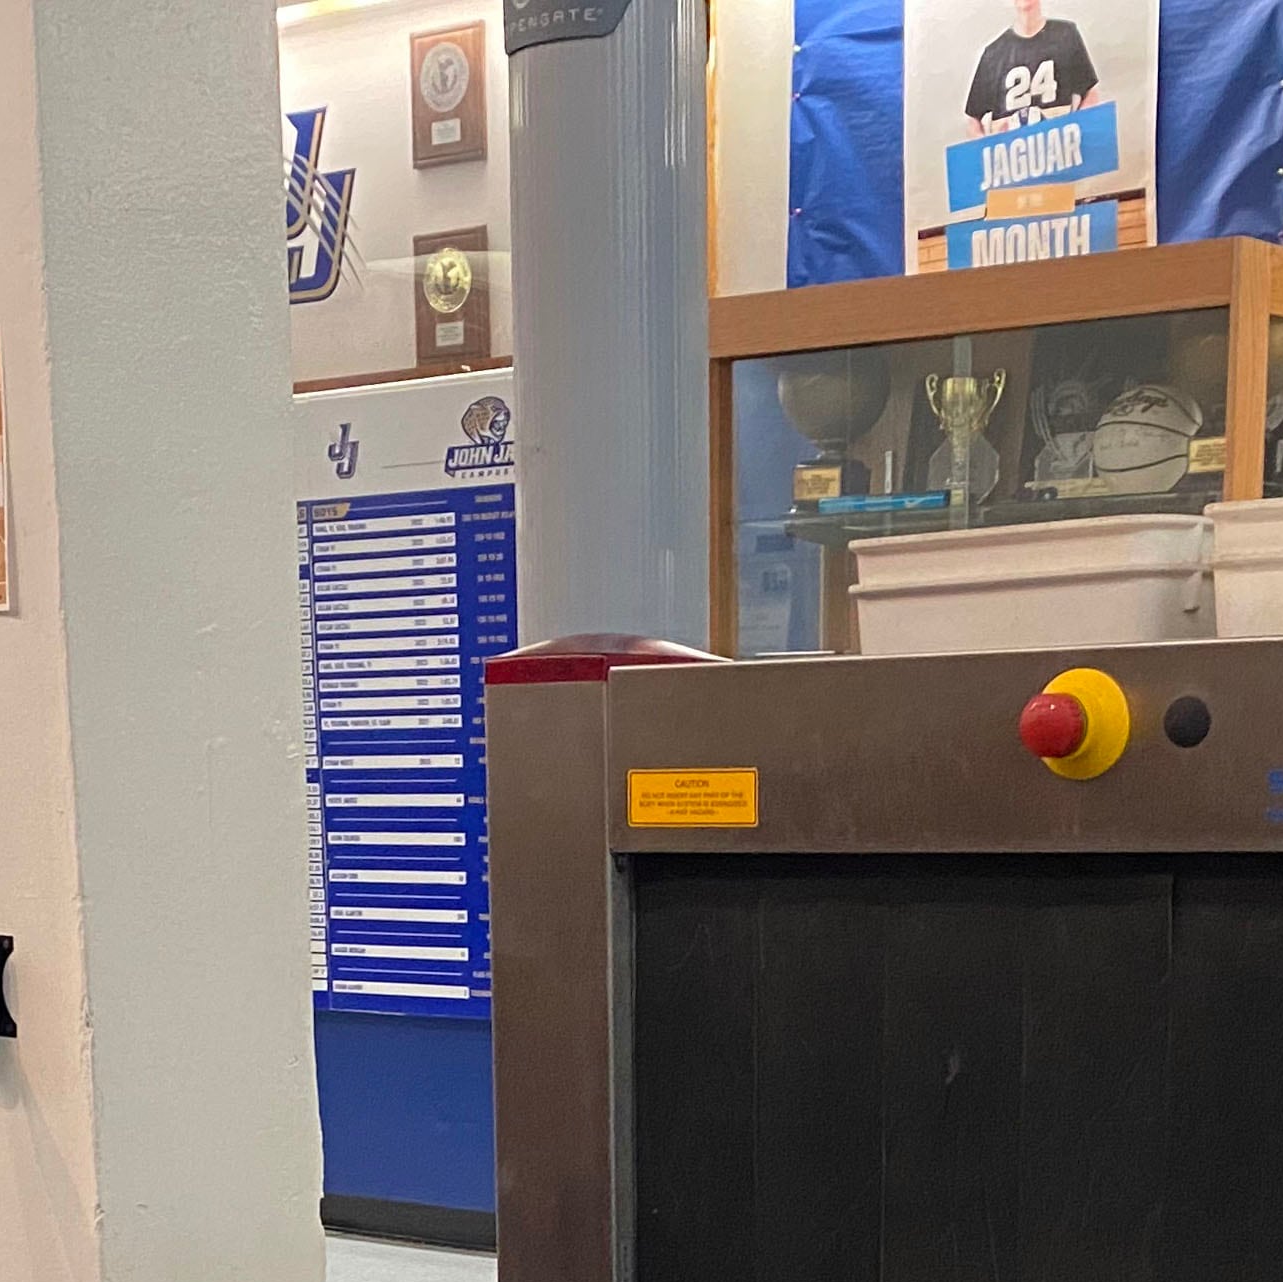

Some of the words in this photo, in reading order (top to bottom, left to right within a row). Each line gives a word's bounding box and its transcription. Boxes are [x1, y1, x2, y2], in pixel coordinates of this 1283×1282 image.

[1005, 59, 1058, 111] 24
[980, 123, 1084, 191] JAGUAR
[971, 214, 1091, 268] MONTH
[447, 449, 491, 468] JOHN
[460, 468, 509, 479] CAMPUS
[674, 779, 710, 788] CAUTION
